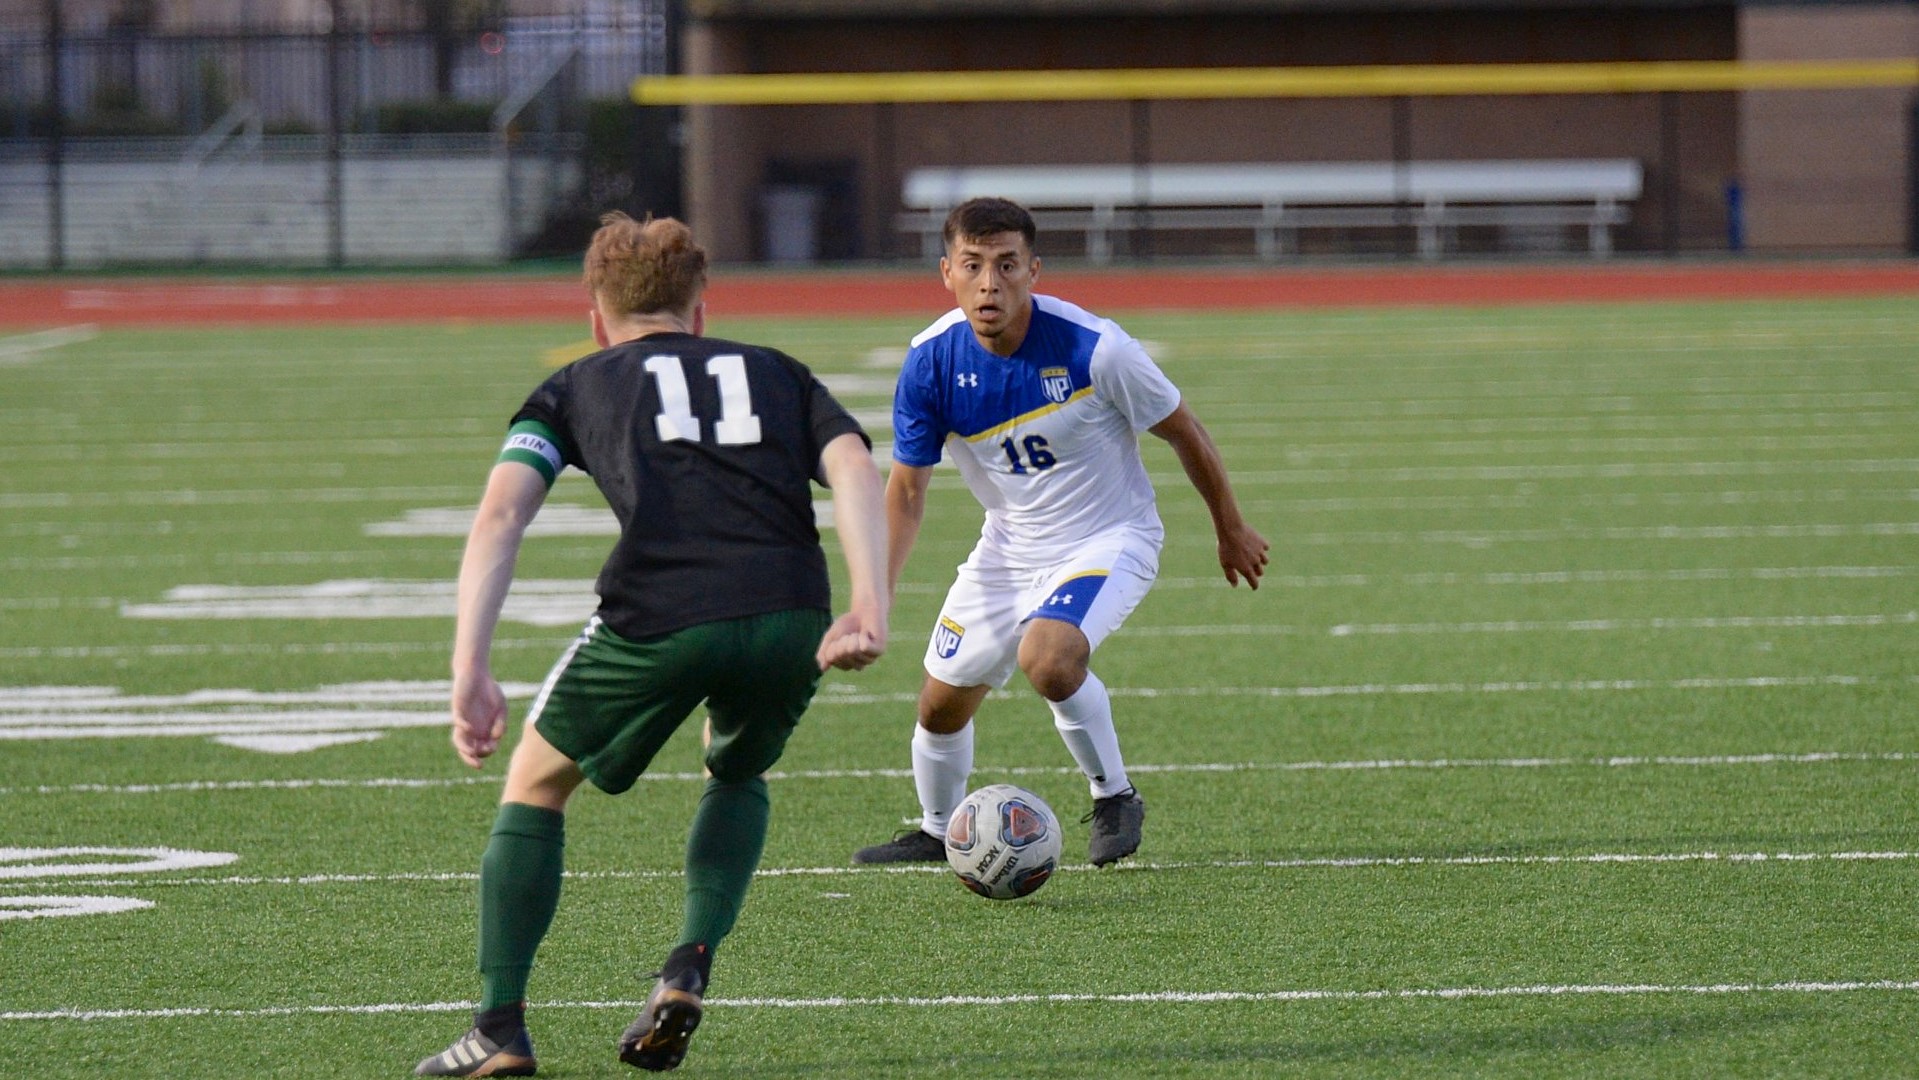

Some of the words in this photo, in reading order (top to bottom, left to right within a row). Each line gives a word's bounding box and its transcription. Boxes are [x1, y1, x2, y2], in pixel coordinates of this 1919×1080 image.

[644, 355, 762, 444] 11
[1043, 376, 1070, 402] NP
[1001, 434, 1057, 474] 16
[936, 624, 961, 658] NP
[976, 845, 1000, 873] NCAA
